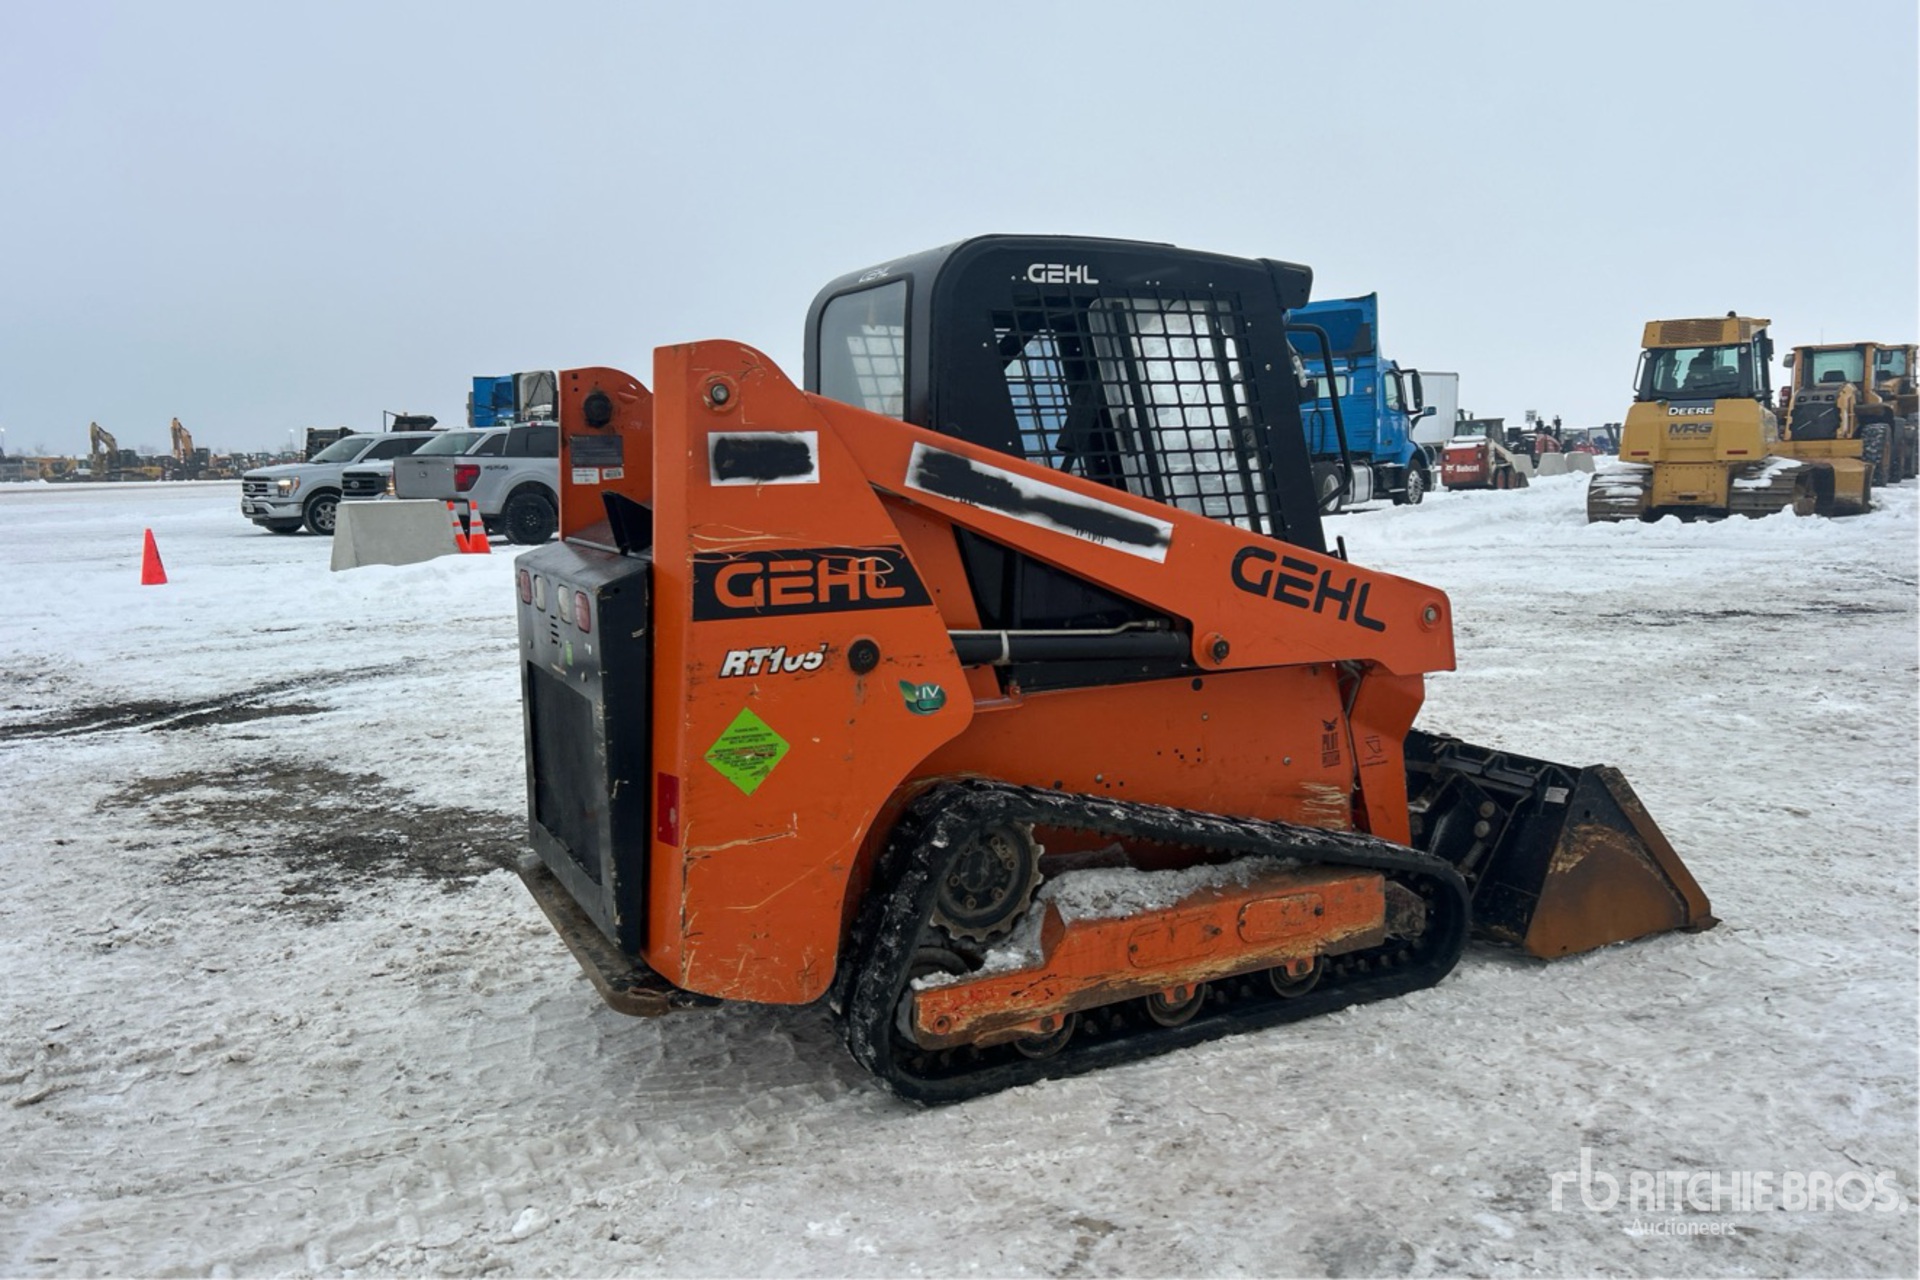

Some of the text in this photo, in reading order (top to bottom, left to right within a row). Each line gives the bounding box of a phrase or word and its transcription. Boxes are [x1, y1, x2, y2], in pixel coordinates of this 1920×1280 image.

[1027, 263, 1099, 284] GEHL
[1668, 407, 1714, 416] DEERE
[1668, 423, 1713, 433] MRG
[1456, 464, 1479, 472] Bobcat
[715, 558, 905, 608] GEHL
[1231, 546, 1386, 632] GEHL
[719, 643, 828, 678] RT105
